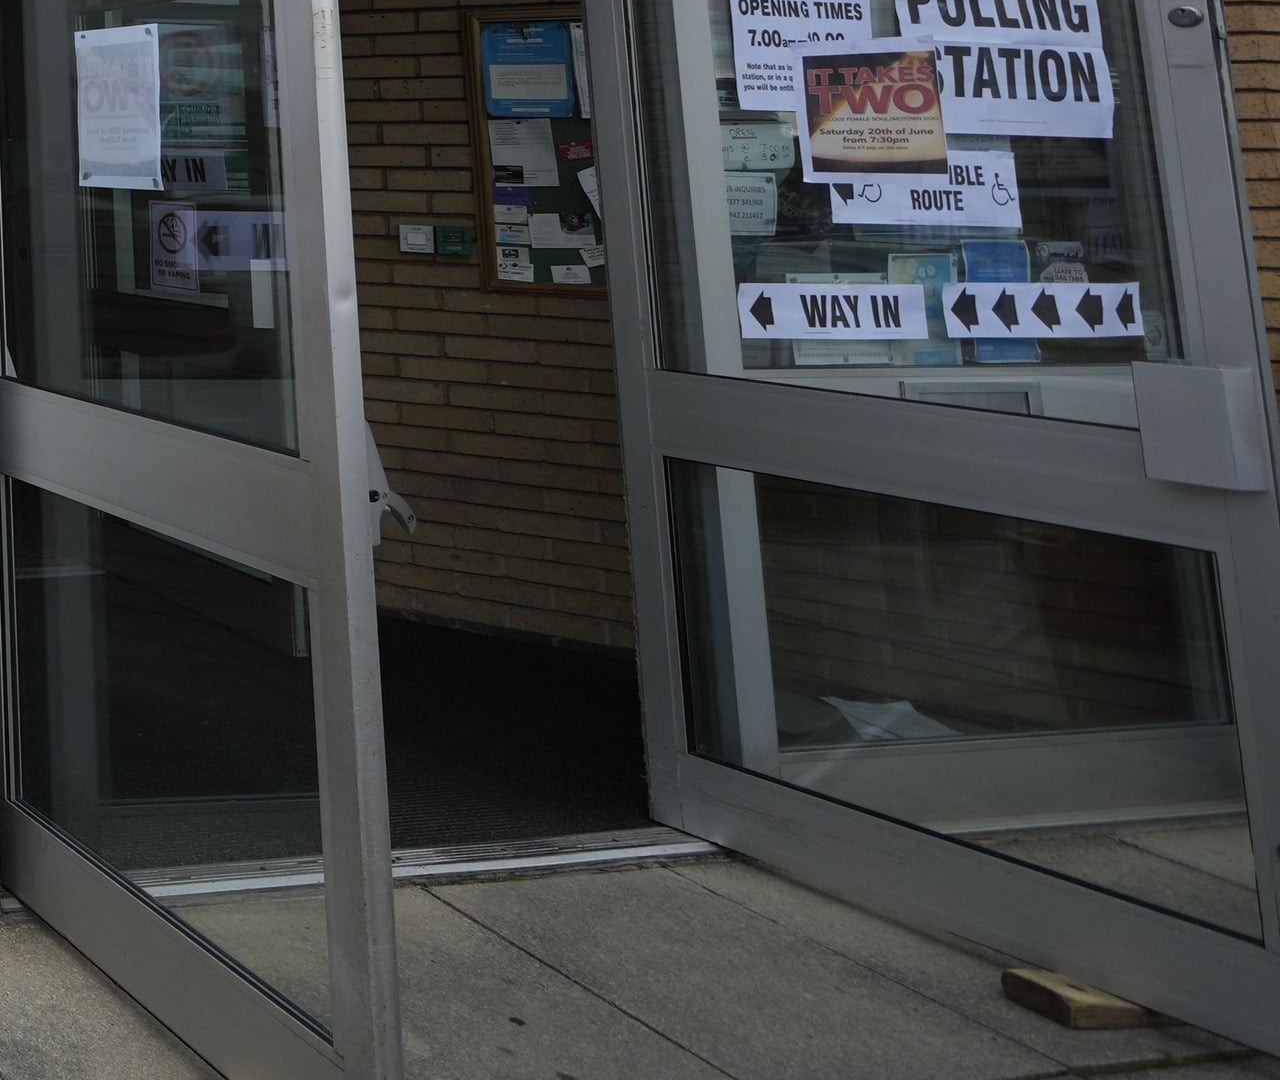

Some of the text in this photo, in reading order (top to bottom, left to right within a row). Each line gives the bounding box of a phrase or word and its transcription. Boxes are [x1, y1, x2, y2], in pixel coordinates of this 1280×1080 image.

[813, 1, 863, 21] TIMES
[748, 29, 796, 48] 7.00a
[807, 65, 934, 86] IT TAKES
[808, 84, 935, 116] TWO
[819, 128, 864, 137] Saturday
[842, 136, 909, 145] from 7:30pm
[161, 158, 206, 182] AY IN
[910, 189, 964, 211] ROUTE
[800, 294, 902, 328] WAY IN
